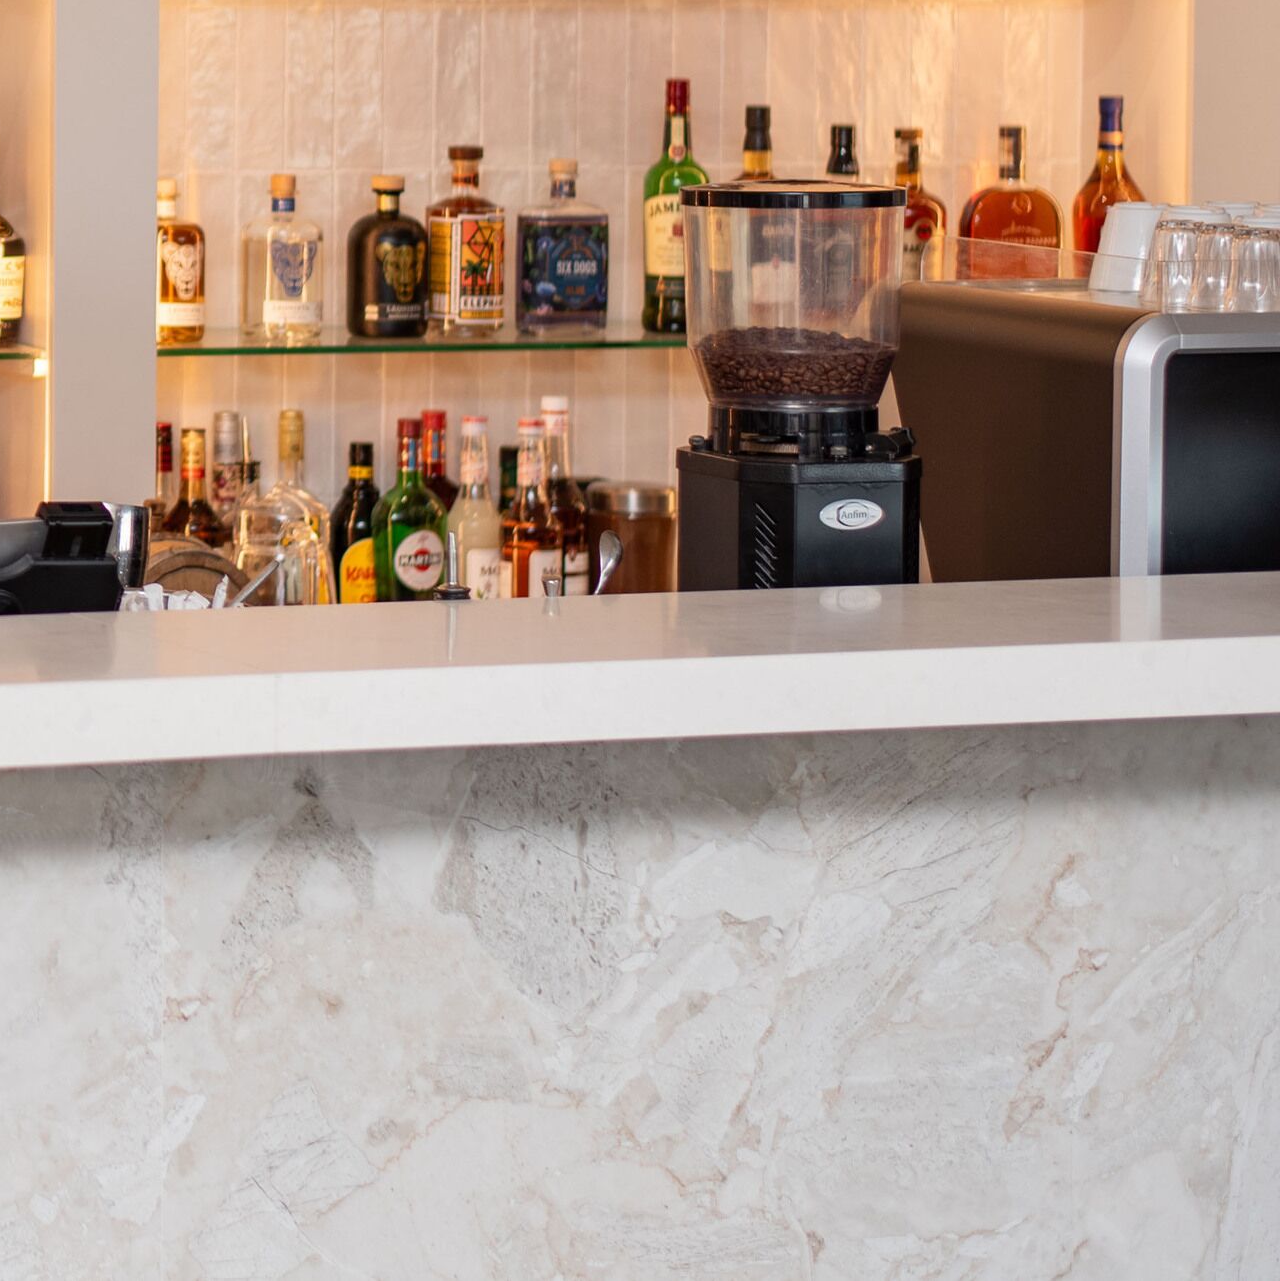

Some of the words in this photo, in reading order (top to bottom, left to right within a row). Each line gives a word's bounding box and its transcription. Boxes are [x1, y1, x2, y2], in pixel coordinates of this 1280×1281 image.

[556, 260, 571, 275] SIX
[573, 260, 598, 275] DOGS
[840, 510, 867, 519] Anfim
